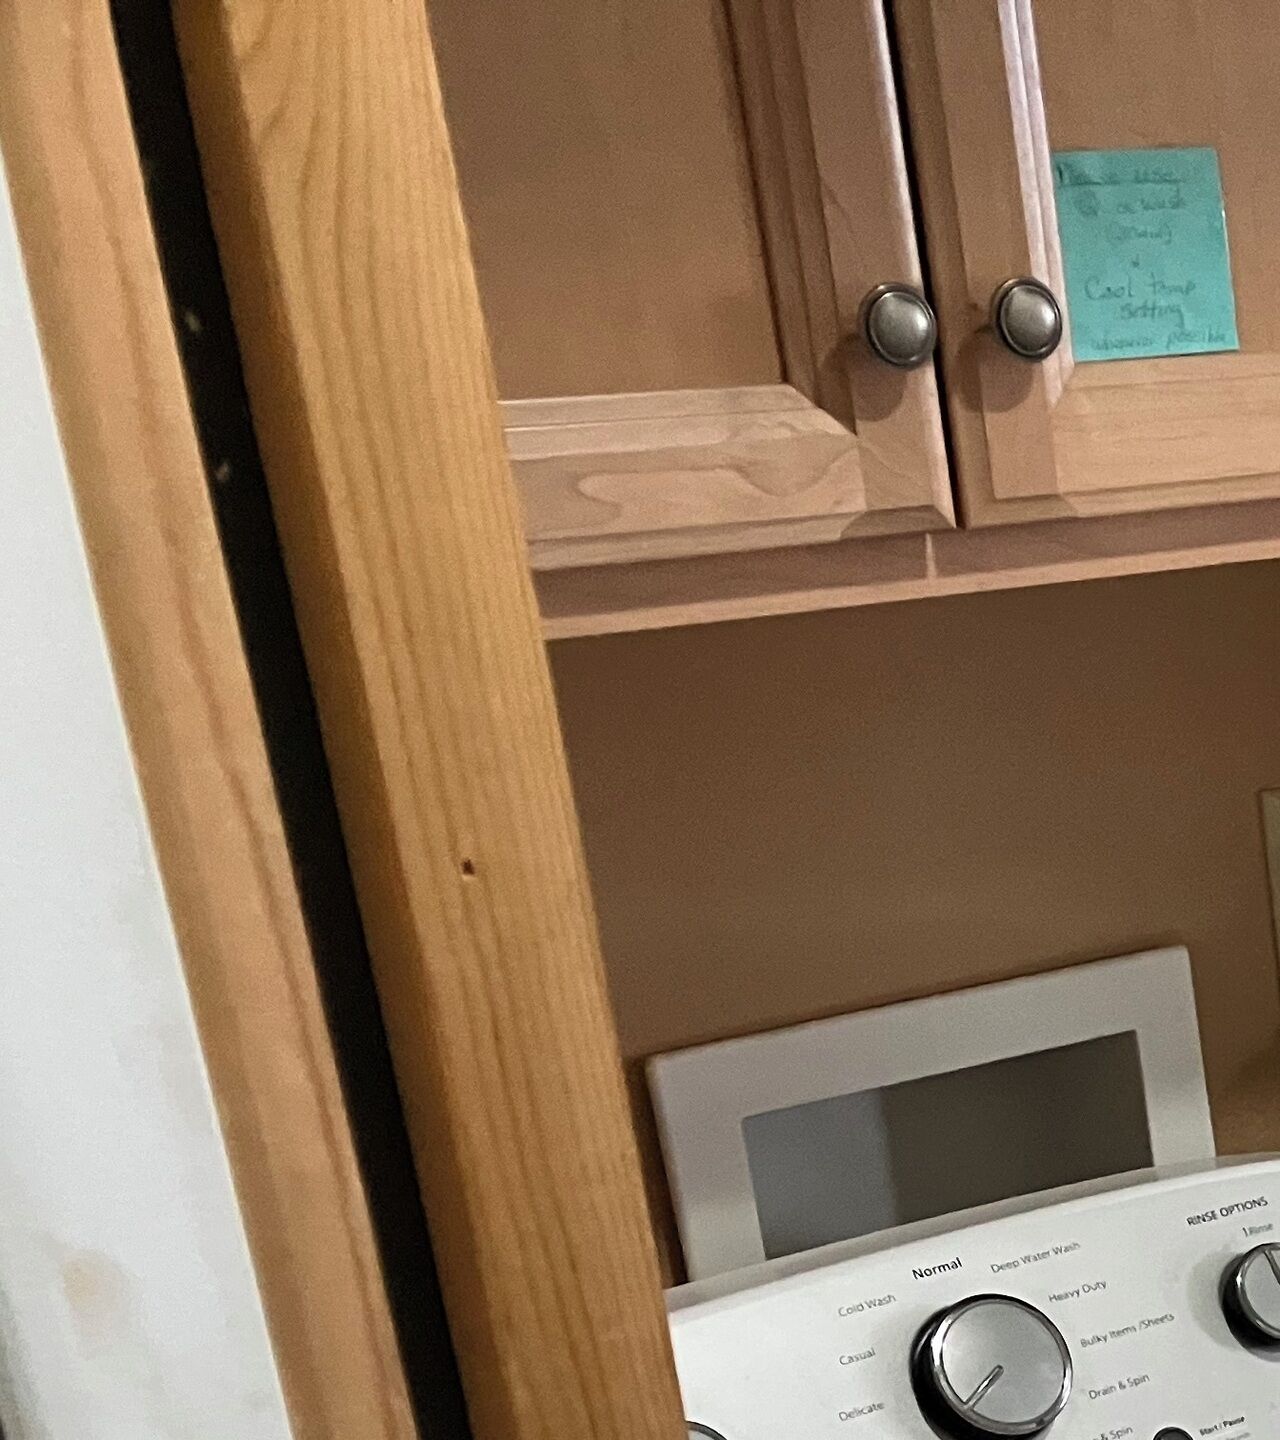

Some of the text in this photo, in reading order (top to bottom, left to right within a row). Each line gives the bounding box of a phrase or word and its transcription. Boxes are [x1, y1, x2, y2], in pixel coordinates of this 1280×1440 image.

[1186, 1196, 1269, 1226] RINSE OPTIONS
[911, 1256, 964, 1281] Normal
[990, 1241, 1081, 1273] Deep Water Wash
[1048, 1279, 1108, 1302] Heavy Duty
[838, 1294, 897, 1317] Cold Wash
[1079, 1333, 1109, 1349] Bulky
[838, 1347, 876, 1366] Casual
[1088, 1385, 1118, 1401] Drain
[1126, 1373, 1151, 1388] Spin
[838, 1401, 886, 1422] Delicate
[1108, 1426, 1134, 1440] Spin
